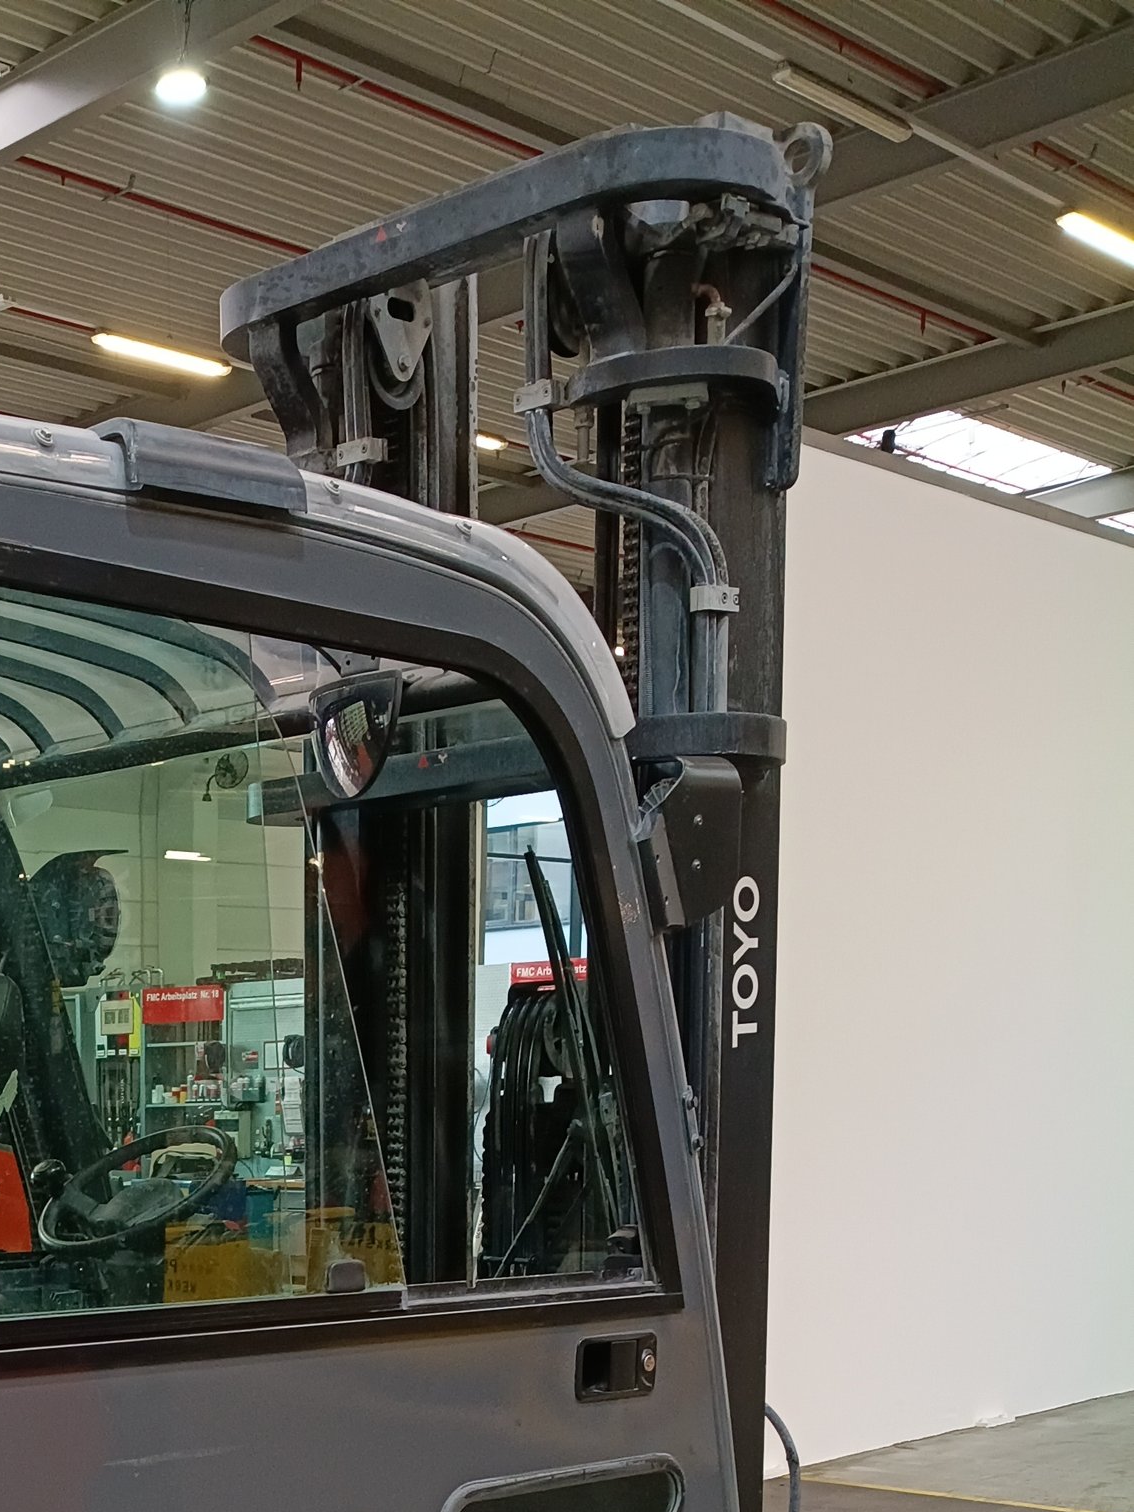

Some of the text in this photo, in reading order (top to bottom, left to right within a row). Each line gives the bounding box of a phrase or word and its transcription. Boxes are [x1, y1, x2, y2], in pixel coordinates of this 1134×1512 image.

[731, 875, 760, 1048] TOYO
[516, 966, 535, 977] FMC
[146, 993, 160, 1002] FMC
[161, 991, 197, 1002] Arbeitsplatz
